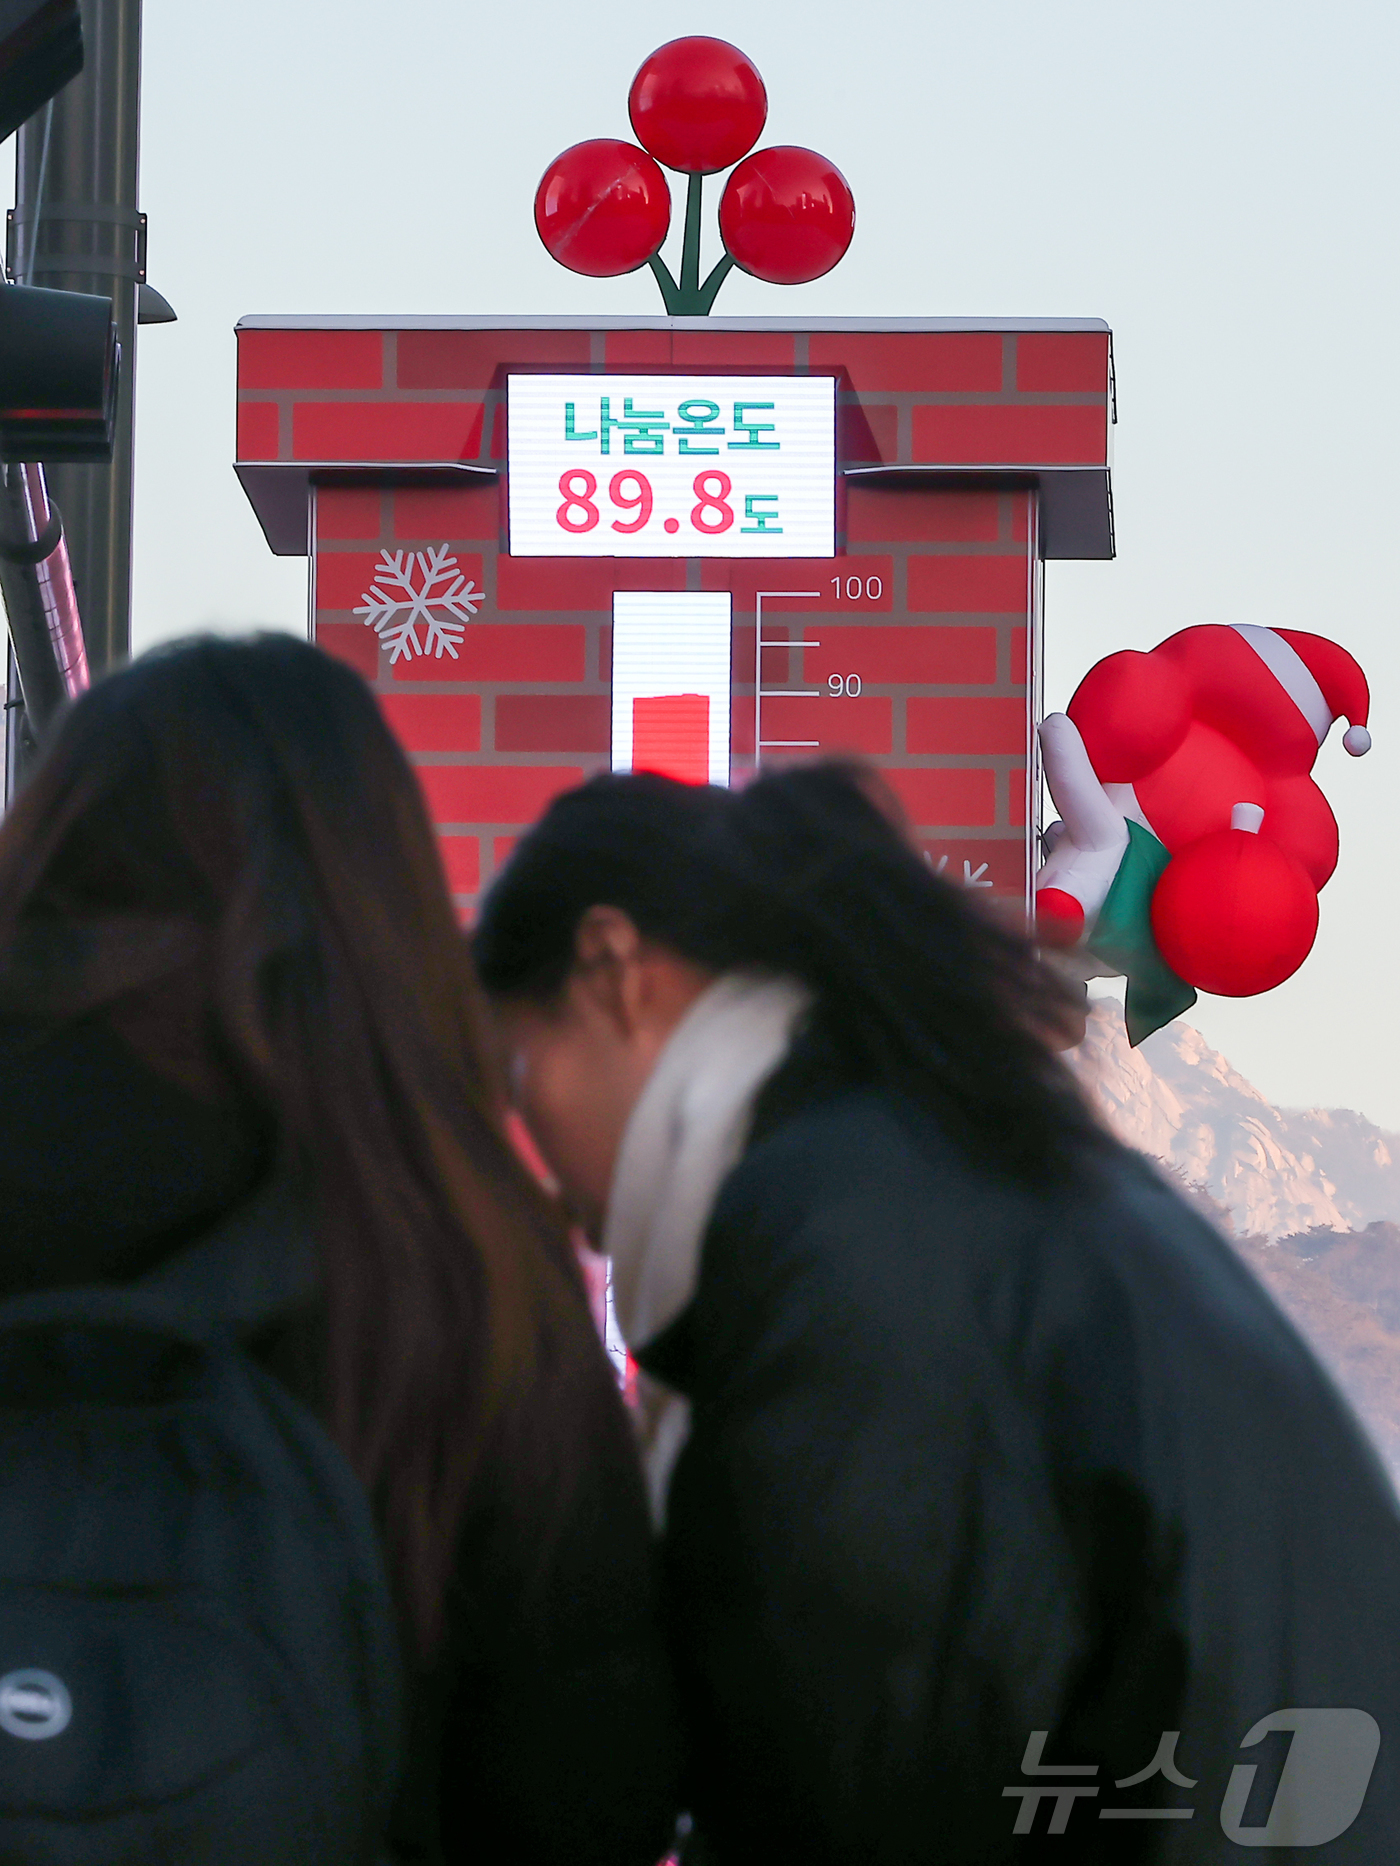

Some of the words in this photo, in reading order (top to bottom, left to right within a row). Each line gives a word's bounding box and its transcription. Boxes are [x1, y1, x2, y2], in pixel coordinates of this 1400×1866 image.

[564, 397, 780, 455] 나눔온도
[556, 469, 783, 534] 89.8도
[830, 576, 883, 600] 100
[827, 674, 862, 698] 90
